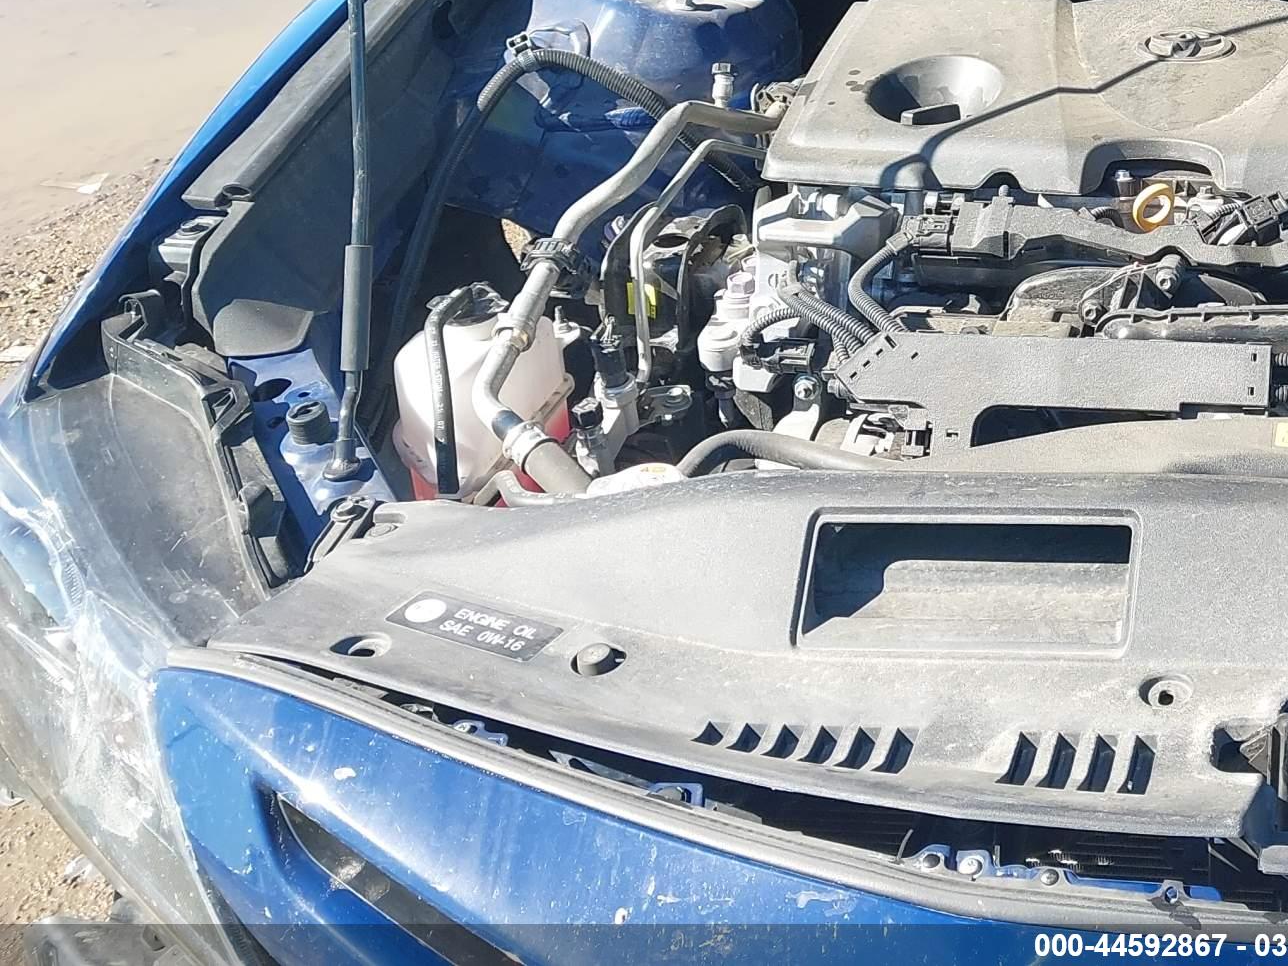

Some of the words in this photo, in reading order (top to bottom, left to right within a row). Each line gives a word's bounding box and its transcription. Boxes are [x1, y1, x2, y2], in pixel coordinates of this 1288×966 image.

[439, 620, 474, 636] SAE
[477, 631, 525, 651] 0W-16
[454, 608, 510, 631] ENGINE
[513, 625, 537, 640] OIL
